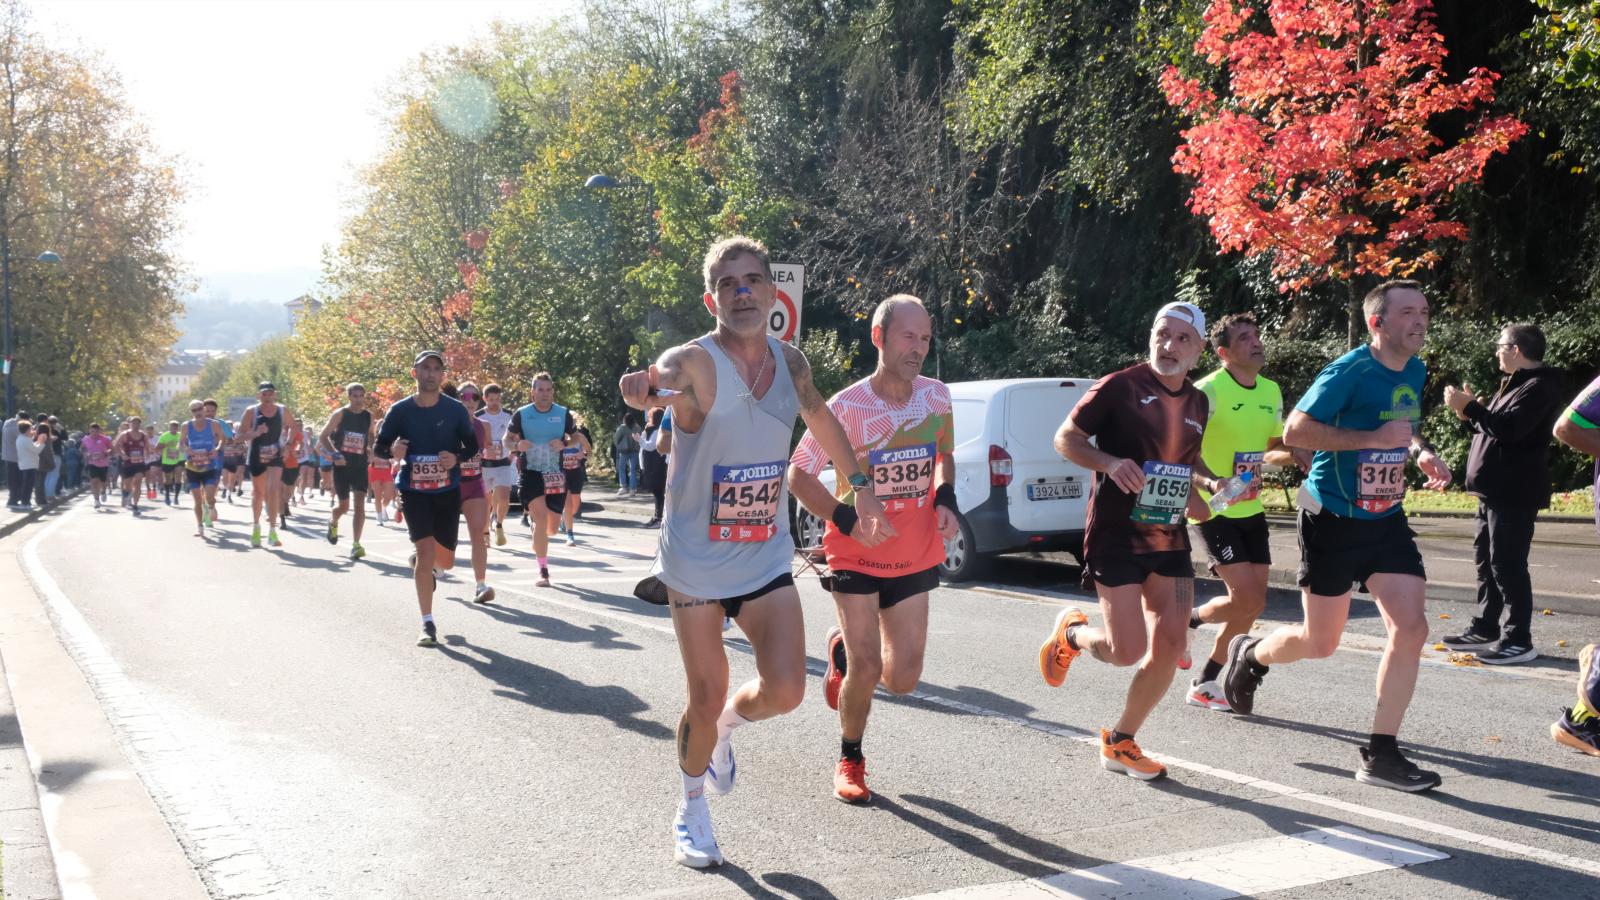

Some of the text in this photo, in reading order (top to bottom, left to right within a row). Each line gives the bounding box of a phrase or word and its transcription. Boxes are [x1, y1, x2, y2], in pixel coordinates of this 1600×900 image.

[875, 460, 932, 485] 3384
[892, 484, 919, 493] MIKEL
[1035, 485, 1059, 497] 3924
[1146, 477, 1190, 498] 1659
[720, 480, 780, 508] 4542
[736, 509, 769, 518] CESAR
[857, 558, 892, 570] Osasun
